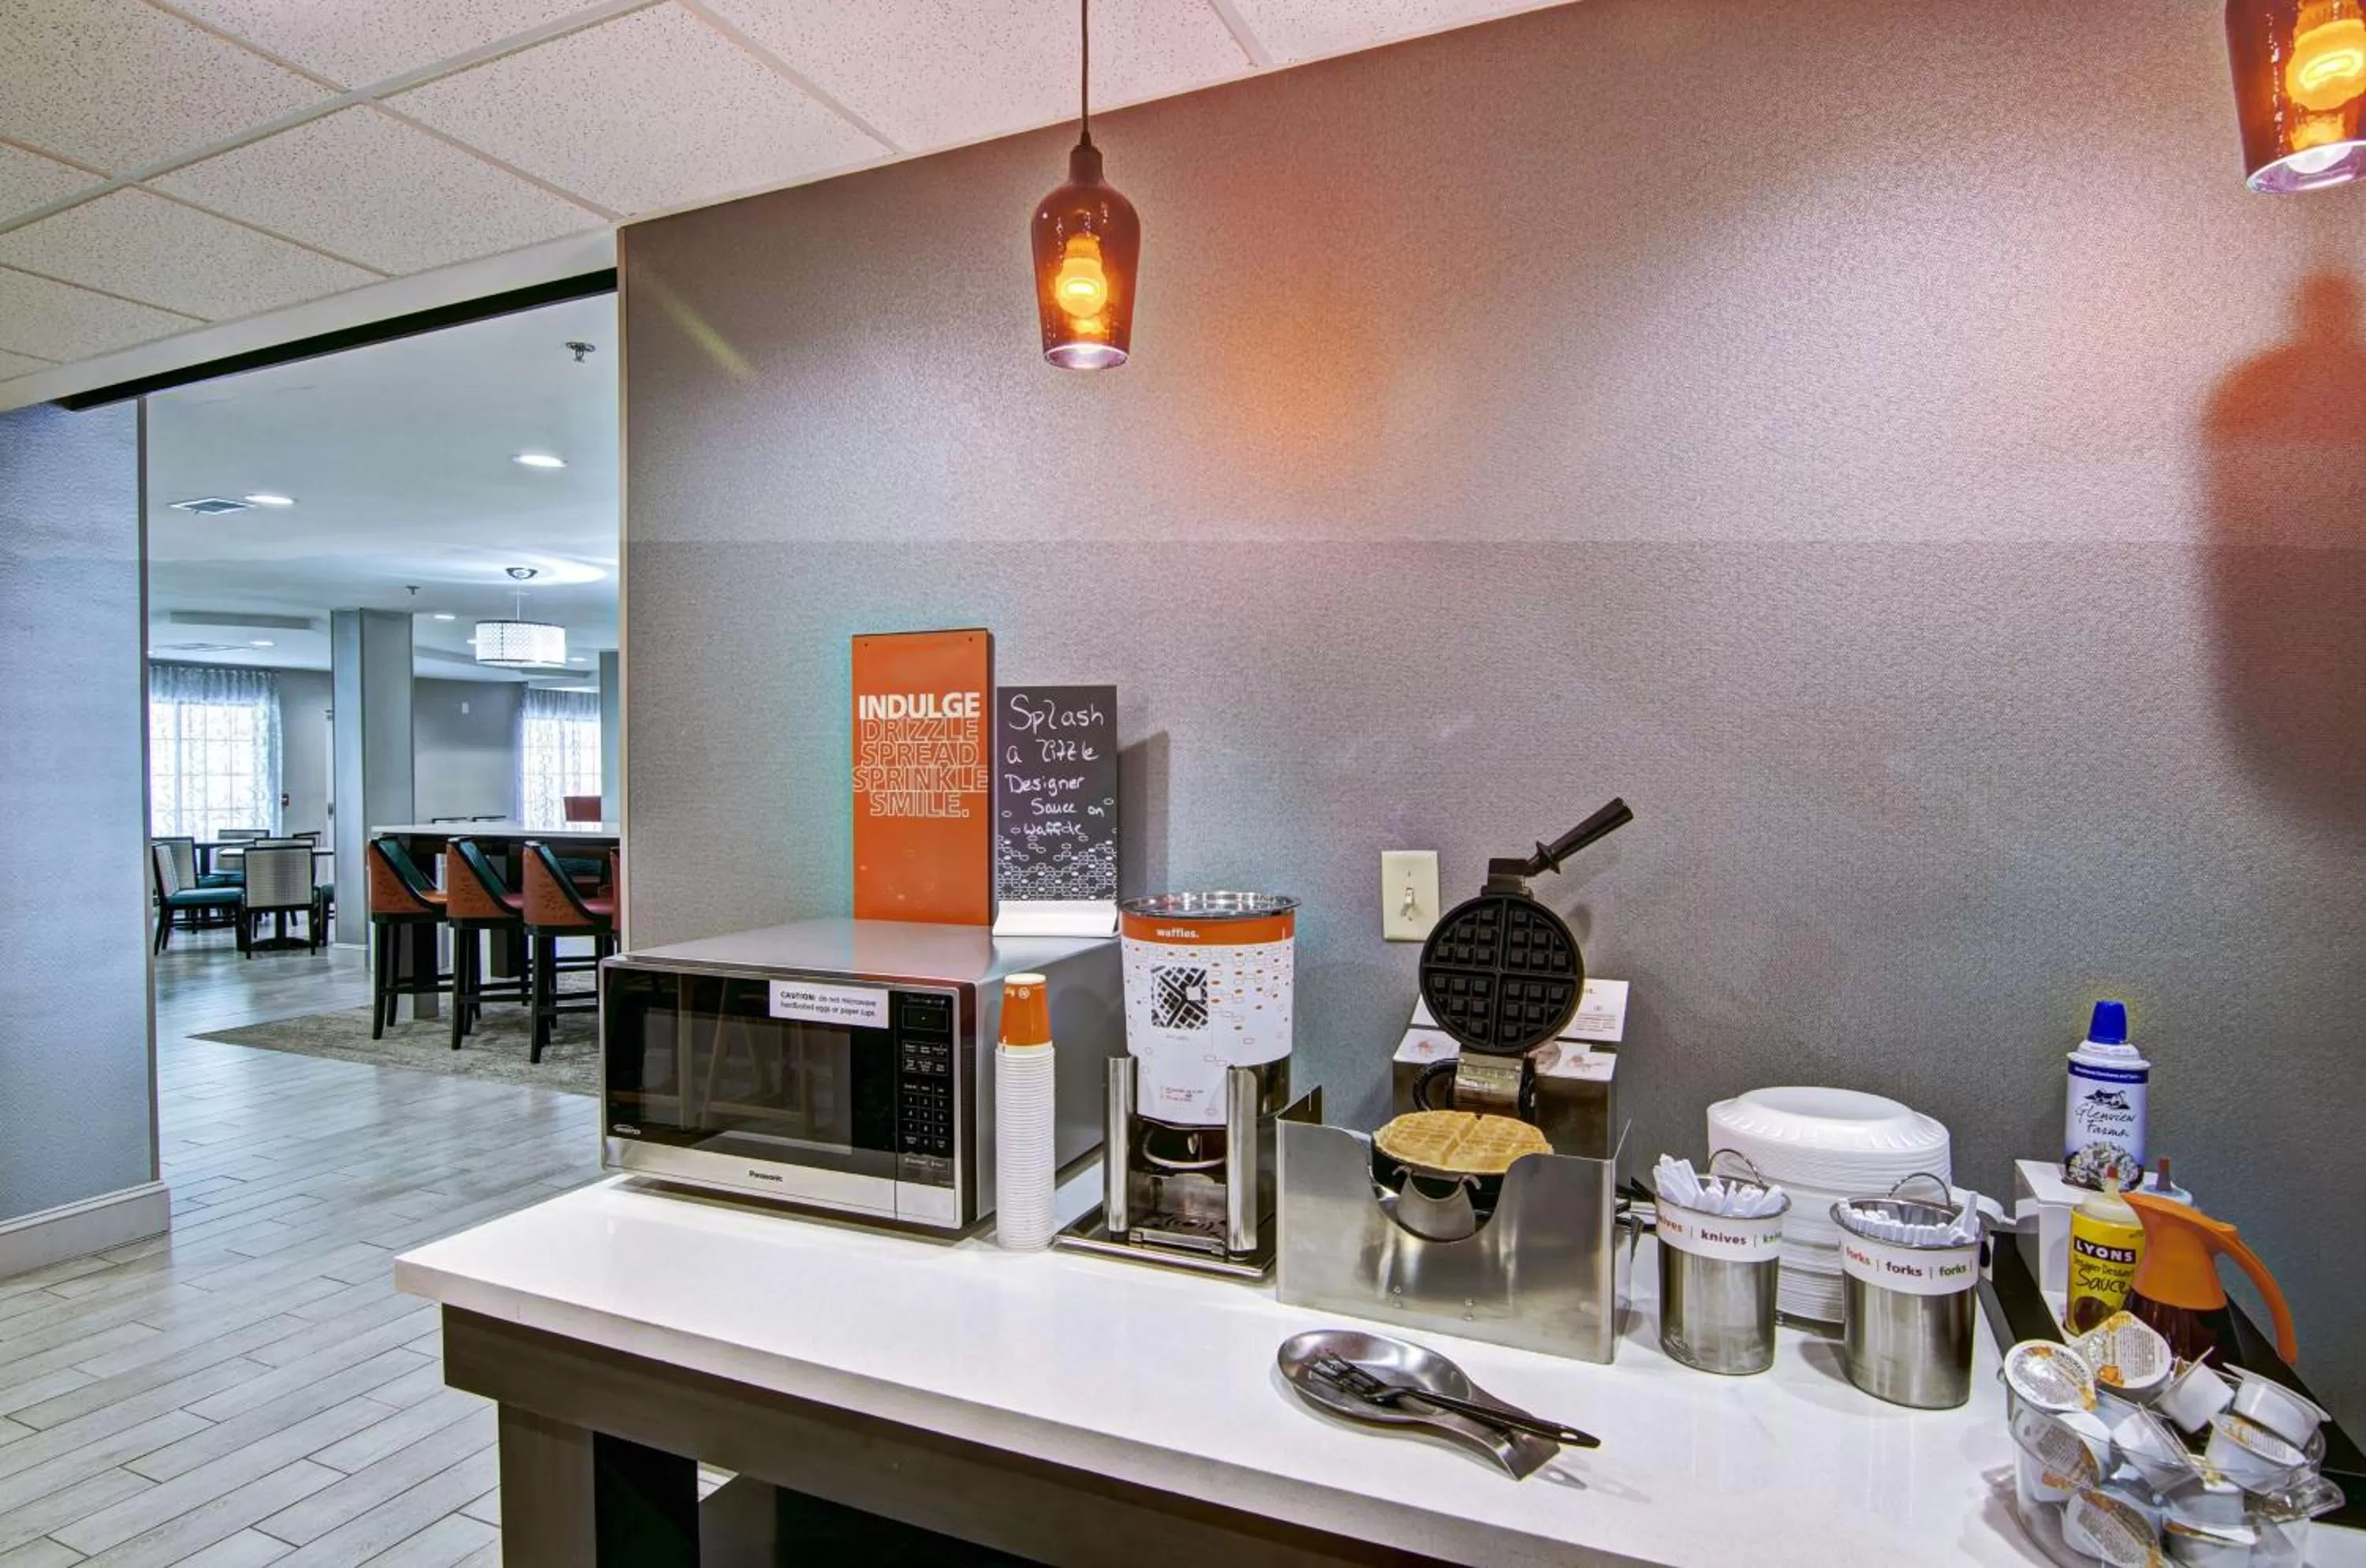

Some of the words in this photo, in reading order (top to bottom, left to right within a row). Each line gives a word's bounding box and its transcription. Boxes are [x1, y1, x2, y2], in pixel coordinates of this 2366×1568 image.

[859, 692, 980, 719] INDULGE
[1009, 693, 1104, 734] Splash
[861, 717, 978, 742] DRIZZLE
[860, 741, 980, 767] SPREAD
[1006, 745, 1022, 764] a
[853, 765, 988, 792] SPRINKLE
[1004, 774, 1085, 797] Designer
[871, 791, 969, 817] SMILE.
[1031, 797, 1077, 815] Sauce
[1088, 805, 1105, 817] on
[1155, 928, 1199, 938] waffles.
[748, 1170, 783, 1182] Panasonic
[1700, 1228, 1747, 1245] knives
[2077, 1239, 2133, 1262] LYONS
[1886, 1261, 1922, 1277] forks
[1939, 1264, 1967, 1277] forks
[2076, 1267, 2132, 1294] Sauce
